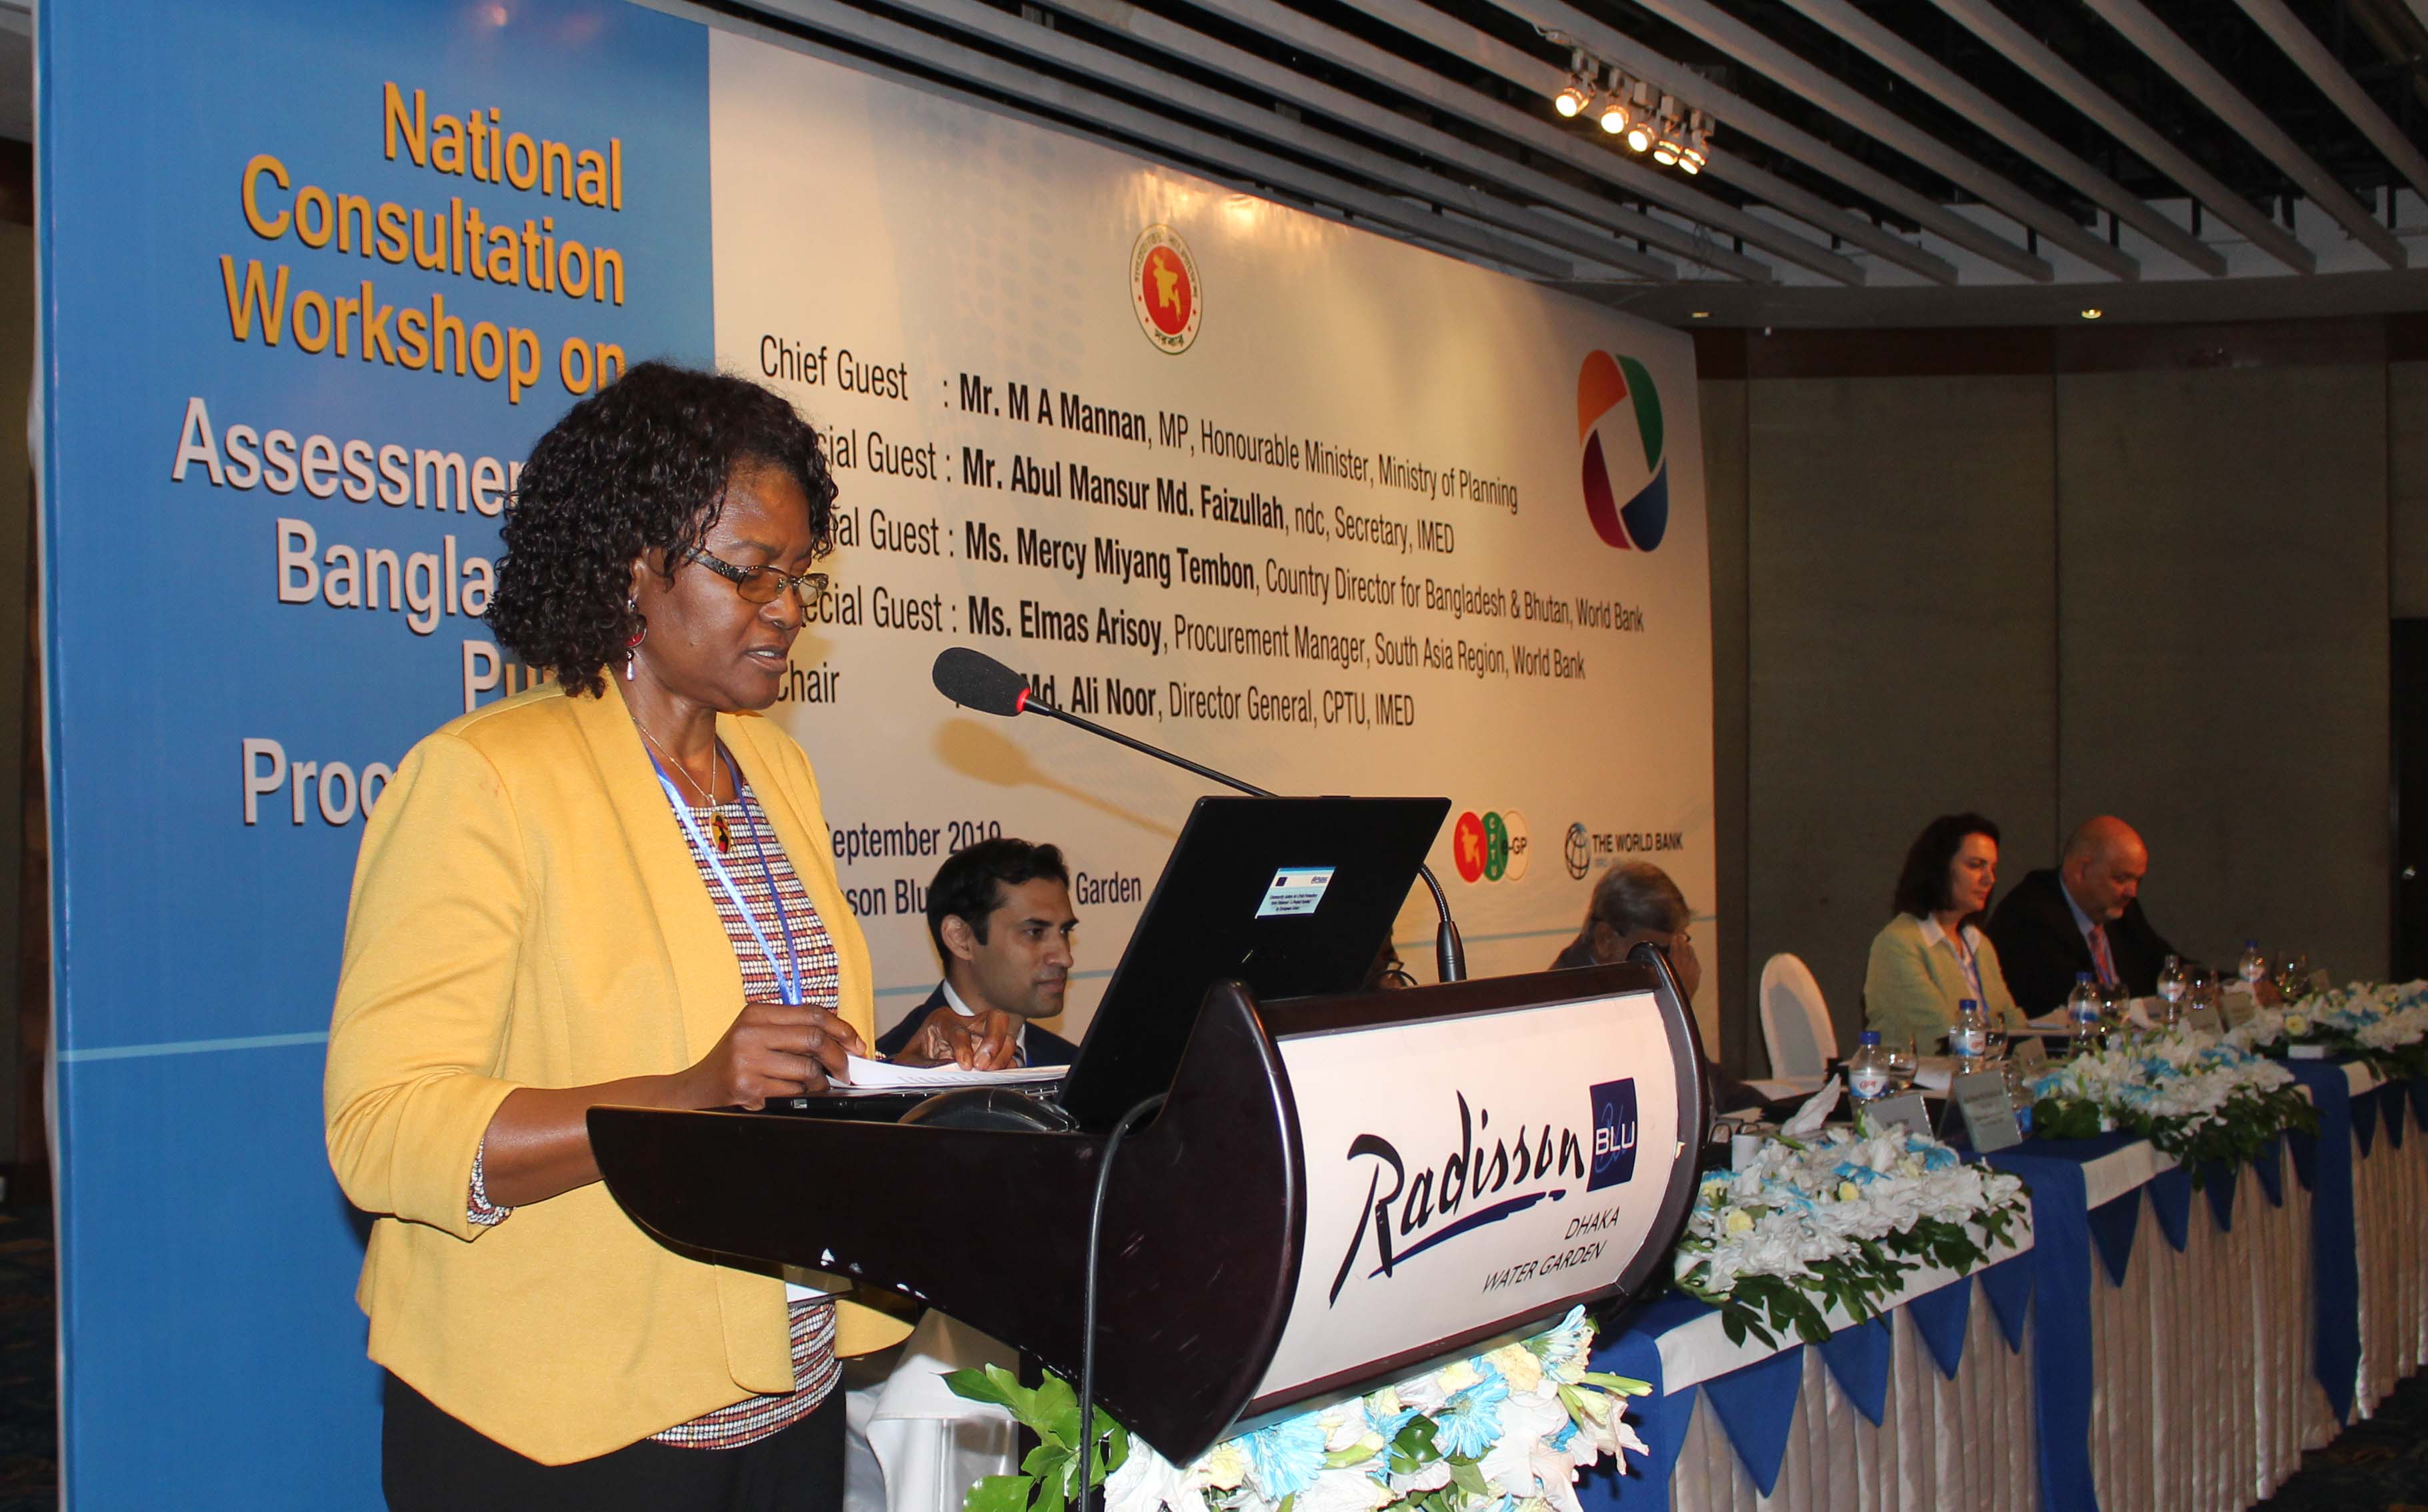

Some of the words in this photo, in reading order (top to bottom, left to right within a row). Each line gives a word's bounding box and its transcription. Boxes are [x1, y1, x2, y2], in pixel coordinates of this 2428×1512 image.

[384, 81, 621, 211] National
[242, 153, 624, 305] Consultation
[220, 253, 541, 404] Workshop
[560, 336, 626, 395] on
[760, 335, 827, 386] Chief
[837, 349, 909, 401] Guest
[943, 379, 949, 407] :
[960, 373, 999, 416] Mr.
[1008, 382, 1029, 422] M
[1037, 388, 1053, 427] A
[1060, 391, 1152, 449] Mannan,
[1201, 419, 1299, 470] Honourable
[1305, 439, 1374, 488] Minister,
[1378, 453, 1436, 501] Ministry
[1442, 467, 1455, 497] of
[1459, 469, 1517, 515] Planning
[867, 431, 937, 480] Guest
[946, 455, 951, 482] :
[962, 446, 1001, 489] Mr.
[1011, 455, 1061, 497] Abul
[1069, 463, 1149, 511] Mansur
[1157, 477, 1194, 517] Md.
[1201, 484, 1289, 535] Faizullah,
[1295, 503, 1329, 538] ndc,
[1335, 506, 1413, 554] Secretary,
[1417, 519, 1455, 554] IMED
[277, 517, 495, 635] Bangla
[871, 509, 939, 555] Guest
[949, 529, 953, 557] :
[965, 521, 1007, 563] Ms.
[1017, 527, 1087, 579] Mercy
[1094, 537, 1171, 588] Miyang
[1176, 547, 1259, 595] Tembon,
[1266, 558, 1329, 605] Country
[1335, 567, 1396, 605] Director
[1401, 576, 1421, 607] for
[1426, 579, 1506, 618] Bangladesh
[1511, 590, 1521, 618] &
[1525, 591, 1573, 629] Bhutan,
[1575, 597, 1611, 629] World
[1615, 601, 1644, 633] Bank
[803, 583, 863, 625] ecial
[873, 586, 943, 631] Guest
[952, 605, 957, 633] :
[969, 595, 1011, 637] Ms.
[1020, 601, 1089, 642] Elmas
[1096, 607, 1168, 655] Arisoy,
[1175, 614, 1289, 658] Procurement
[1295, 626, 1370, 669] Manager,
[1375, 631, 1419, 667] South
[1423, 639, 1453, 669] Asia
[1458, 641, 1509, 679] Region,
[1512, 645, 1549, 677] World
[1554, 649, 1585, 679] Bank
[1071, 676, 1099, 713] Ali
[1106, 678, 1163, 723] Noor,
[1169, 681, 1241, 720] Director
[1247, 685, 1317, 727] General,
[1323, 691, 1371, 729] CPTU,
[1375, 694, 1415, 726] IMED
[825, 821, 941, 865] eptember
[841, 887, 885, 916] son
[895, 879, 928, 914] Blu
[1076, 871, 1141, 905] Garden
[1502, 837, 1527, 855] e-GP
[1593, 834, 1613, 853] THE
[1615, 833, 1653, 852] WORLD
[1655, 833, 1683, 850] BANK
[1329, 1090, 1584, 1309] Radisson
[1595, 1121, 1635, 1155] BLU
[1564, 1207, 1620, 1240] DHAKA
[1483, 1261, 1537, 1293] WATER
[1539, 1241, 1607, 1276] GARDEN
